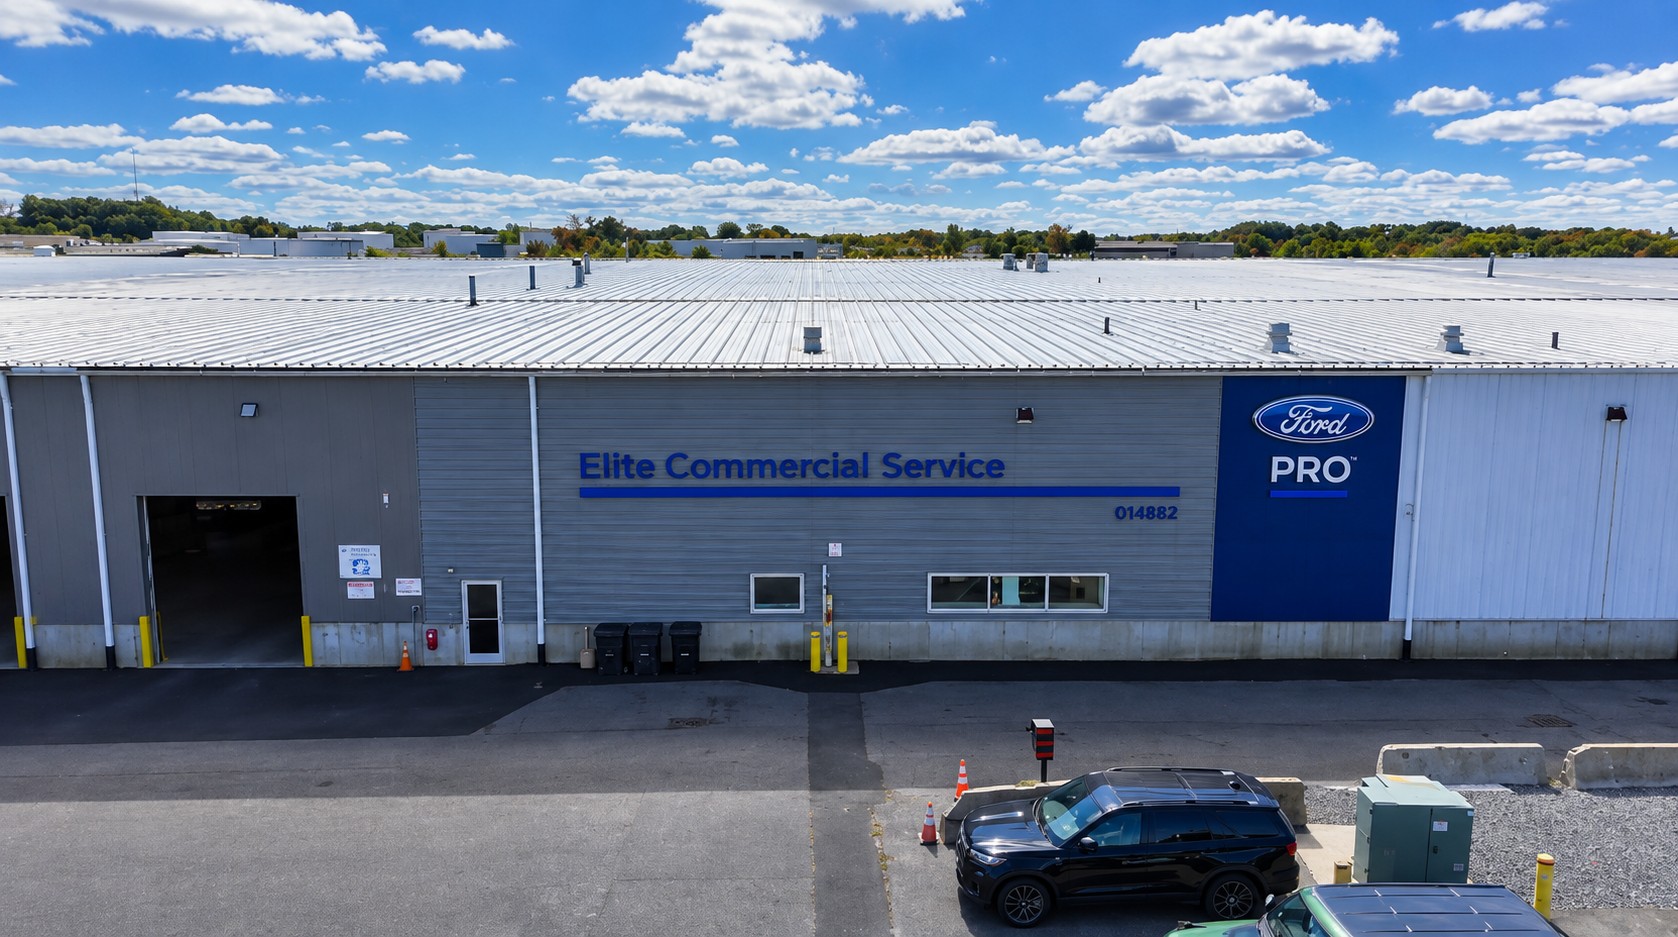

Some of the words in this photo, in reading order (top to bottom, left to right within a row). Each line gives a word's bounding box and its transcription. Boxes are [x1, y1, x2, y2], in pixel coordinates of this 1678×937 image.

[1280, 404, 1350, 435] Ford
[579, 451, 655, 480] Elite
[665, 451, 869, 479] Commercial
[882, 451, 1005, 479] Service
[1115, 505, 1178, 520] 014882
